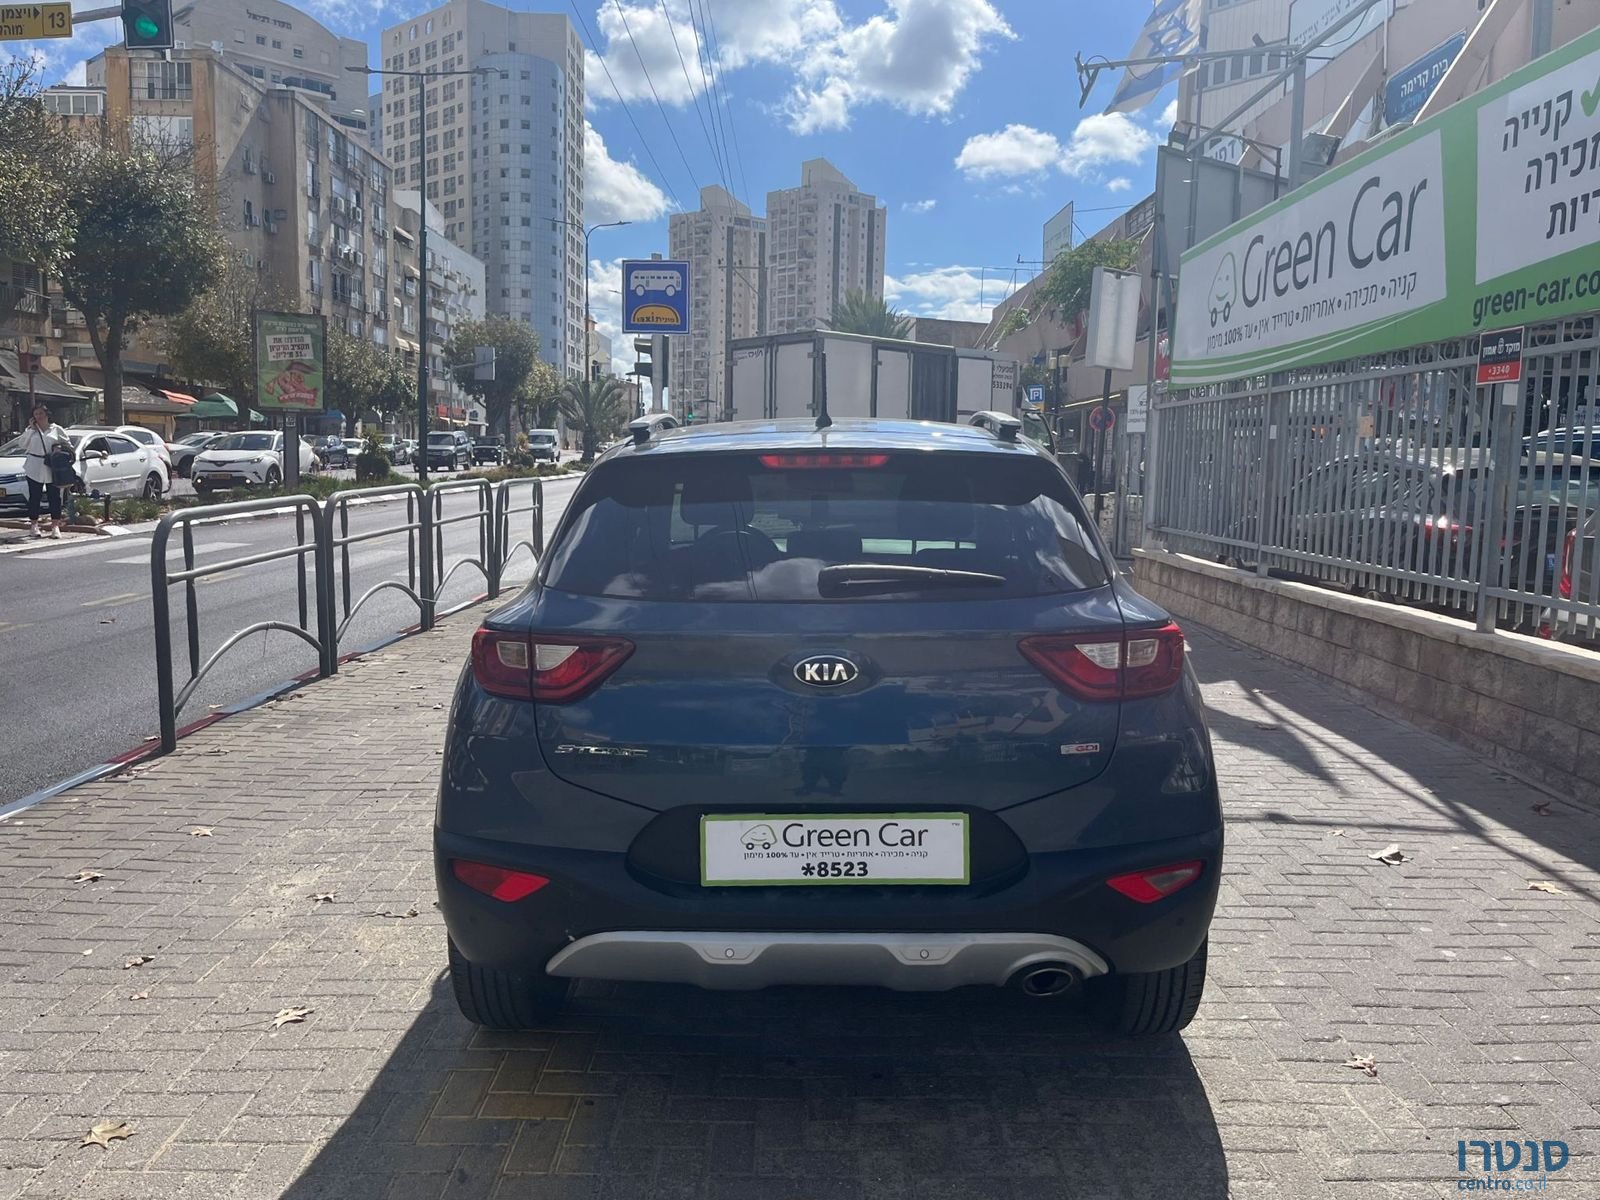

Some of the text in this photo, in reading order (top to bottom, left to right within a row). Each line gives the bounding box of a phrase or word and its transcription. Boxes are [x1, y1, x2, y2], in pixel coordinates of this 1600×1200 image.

[1, 7, 31, 23] ויצמן
[48, 11, 66, 29] 13
[1400, 58, 1449, 98] בית קדימה
[1502, 89, 1573, 152] קנייה
[1242, 176, 1428, 308] Green Car
[1387, 271, 1417, 300] קניה
[1344, 283, 1378, 311] מכירה
[1301, 296, 1336, 323] אחריות
[1258, 317, 1270, 340] אין
[1271, 310, 1294, 331] טרייד
[1224, 326, 1243, 346] 100%
[1244, 323, 1254, 339] עד
[1505, 342, 1521, 355] מוקד
[804, 663, 849, 681] KIA
[782, 822, 929, 848] Green Car
[743, 852, 764, 860] מימון
[766, 851, 789, 859] 100%
[806, 851, 817, 860] אין
[846, 850, 874, 858] אחריות
[880, 850, 905, 858] מכירה
[910, 850, 929, 859] קניה
